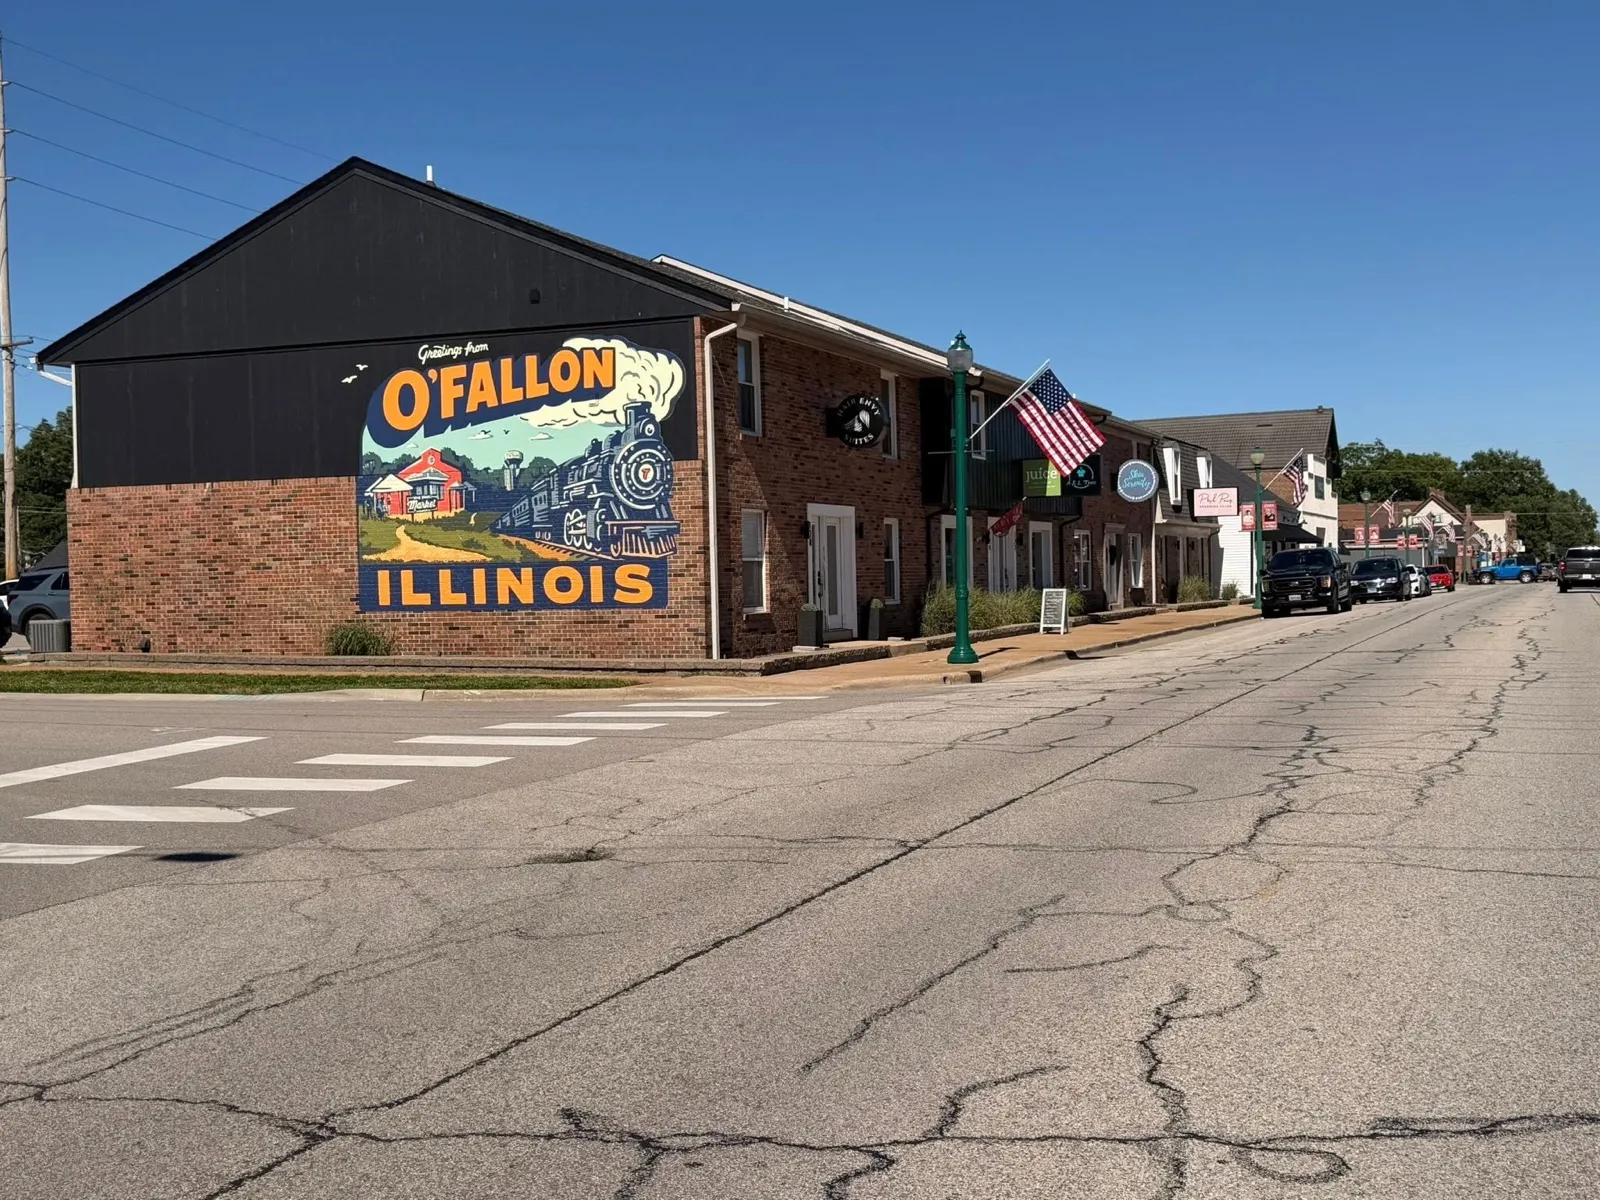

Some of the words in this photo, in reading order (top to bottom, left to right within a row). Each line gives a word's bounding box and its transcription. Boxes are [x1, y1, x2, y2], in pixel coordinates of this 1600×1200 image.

[417, 344, 463, 365] Greetings
[464, 341, 489, 357] from
[383, 349, 616, 431] O'FALLON
[837, 398, 857, 417] HAIR
[859, 397, 881, 416] ENVY
[844, 432, 874, 445] SUITES
[641, 468, 651, 480] 7
[1025, 467, 1057, 483] juice
[377, 563, 653, 606] ILLINOIS
